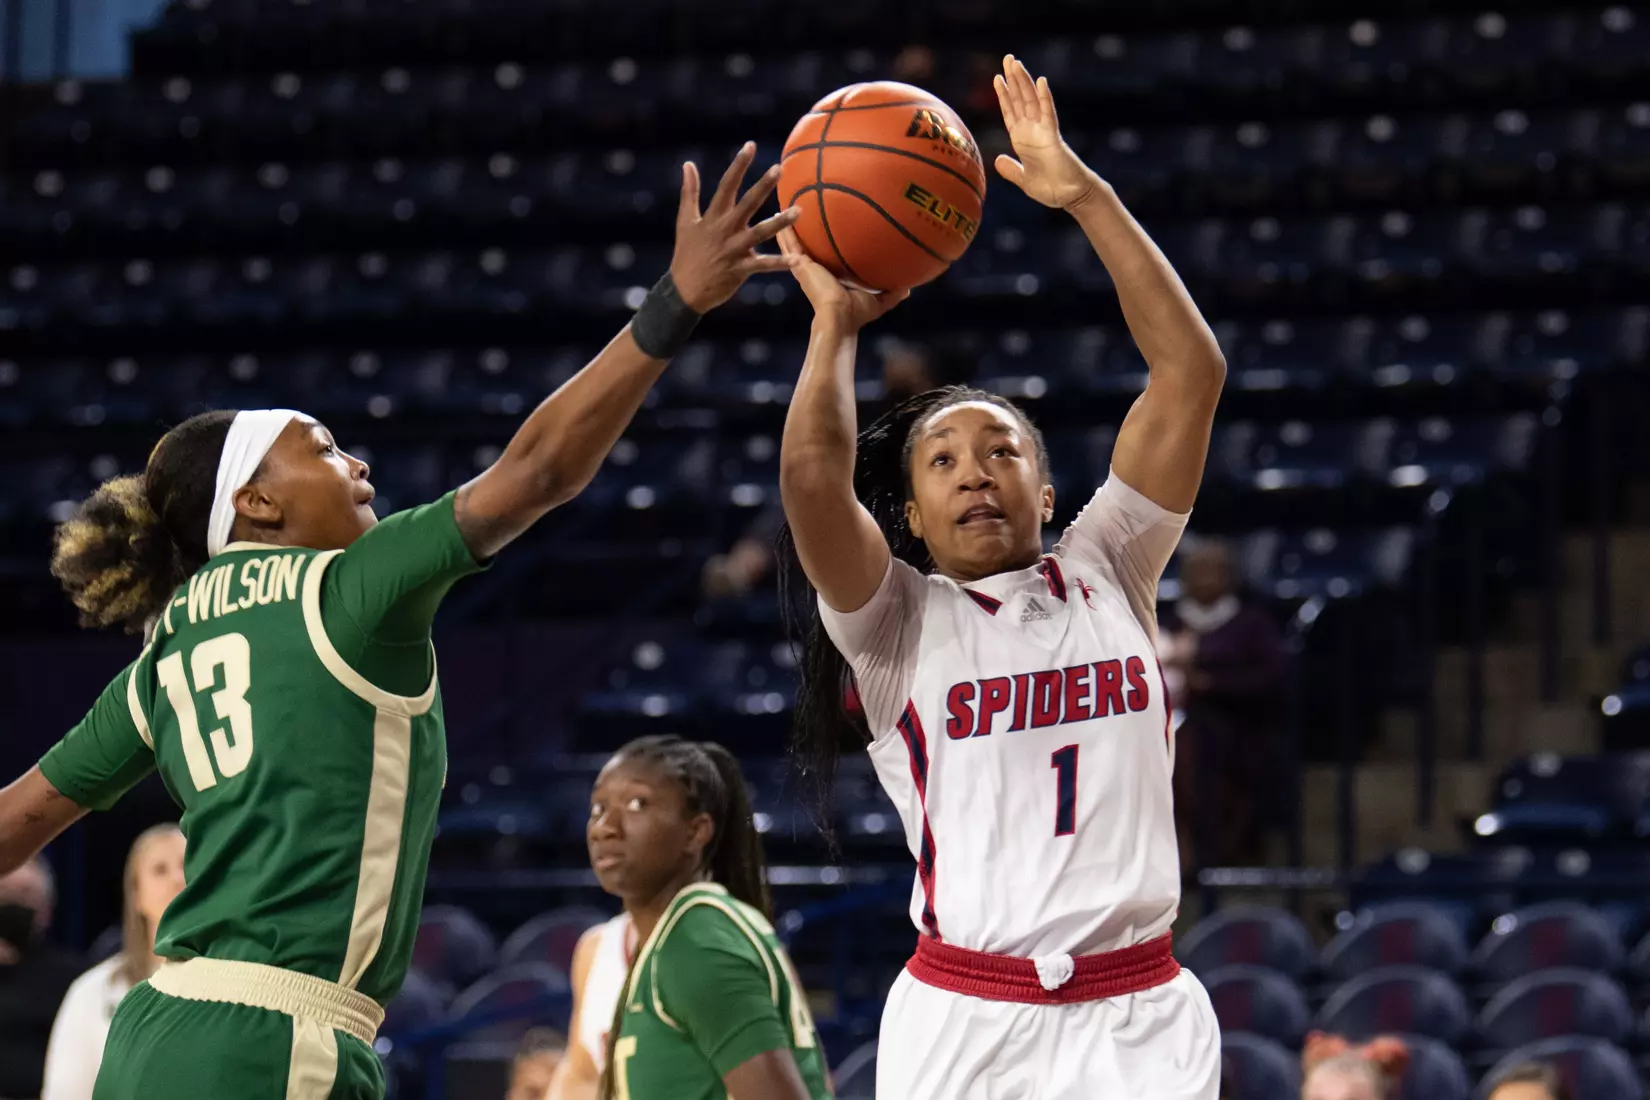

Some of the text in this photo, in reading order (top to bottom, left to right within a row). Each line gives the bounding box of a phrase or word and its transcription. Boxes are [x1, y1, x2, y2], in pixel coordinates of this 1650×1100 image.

[904, 182, 980, 242] ELITE
[156, 631, 254, 793] 13
[946, 655, 1150, 741] SPIDERS
[1051, 743, 1080, 838] 1
